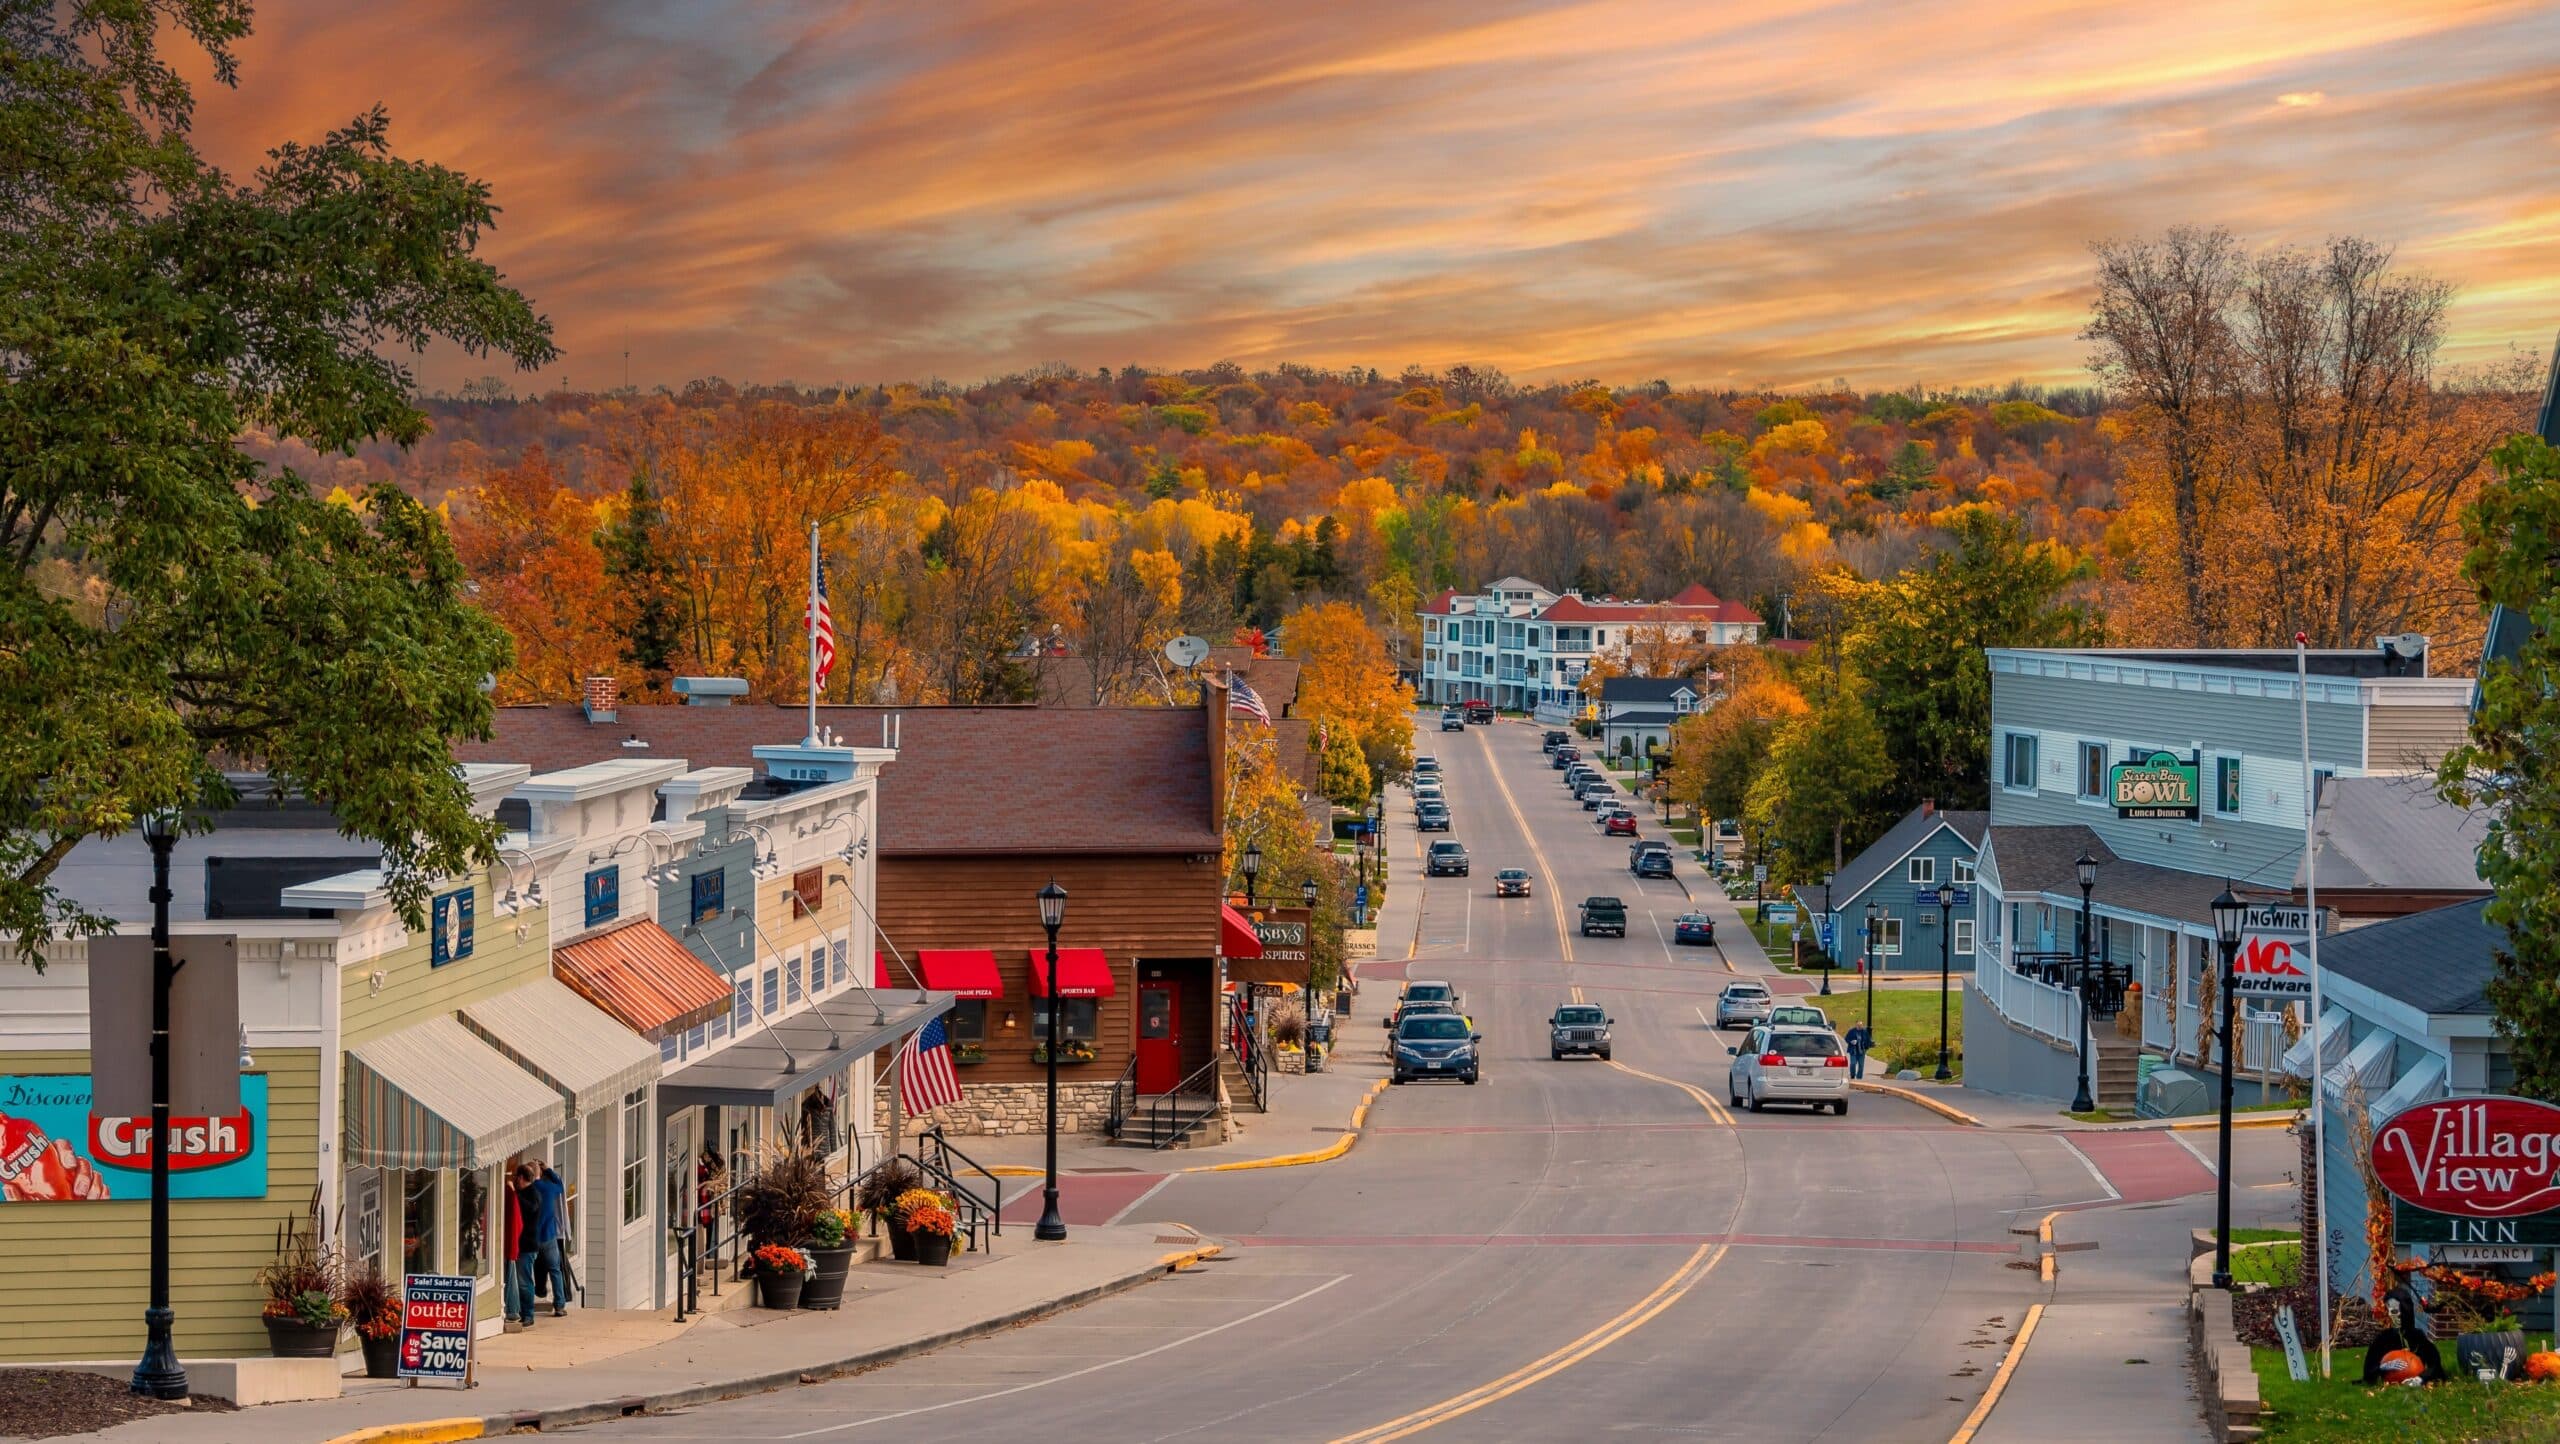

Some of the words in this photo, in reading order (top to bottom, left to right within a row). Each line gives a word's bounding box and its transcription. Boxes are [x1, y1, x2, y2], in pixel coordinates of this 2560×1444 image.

[2123, 768, 2156, 781] Sister
[2160, 768, 2181, 784] Bay
[2117, 780, 2192, 804] BOWL
[1823, 923, 1831, 932] P
[1265, 950, 1306, 961] SPIRITS
[1254, 986, 1281, 996] OPEN
[99, 1116, 237, 1156] Crush
[2450, 1220, 2518, 1243] INN
[2463, 1249, 2529, 1260] VACANCY
[414, 1277, 433, 1287] Sale!
[434, 1278, 453, 1287] Sale!
[454, 1279, 472, 1288] Sale!
[411, 1291, 430, 1301] ON
[433, 1292, 466, 1303] DECK
[411, 1302, 465, 1319] outlet
[436, 1319, 463, 1329] store
[409, 1338, 419, 1348] Up
[420, 1331, 467, 1351] Save
[423, 1351, 465, 1369] 70%
